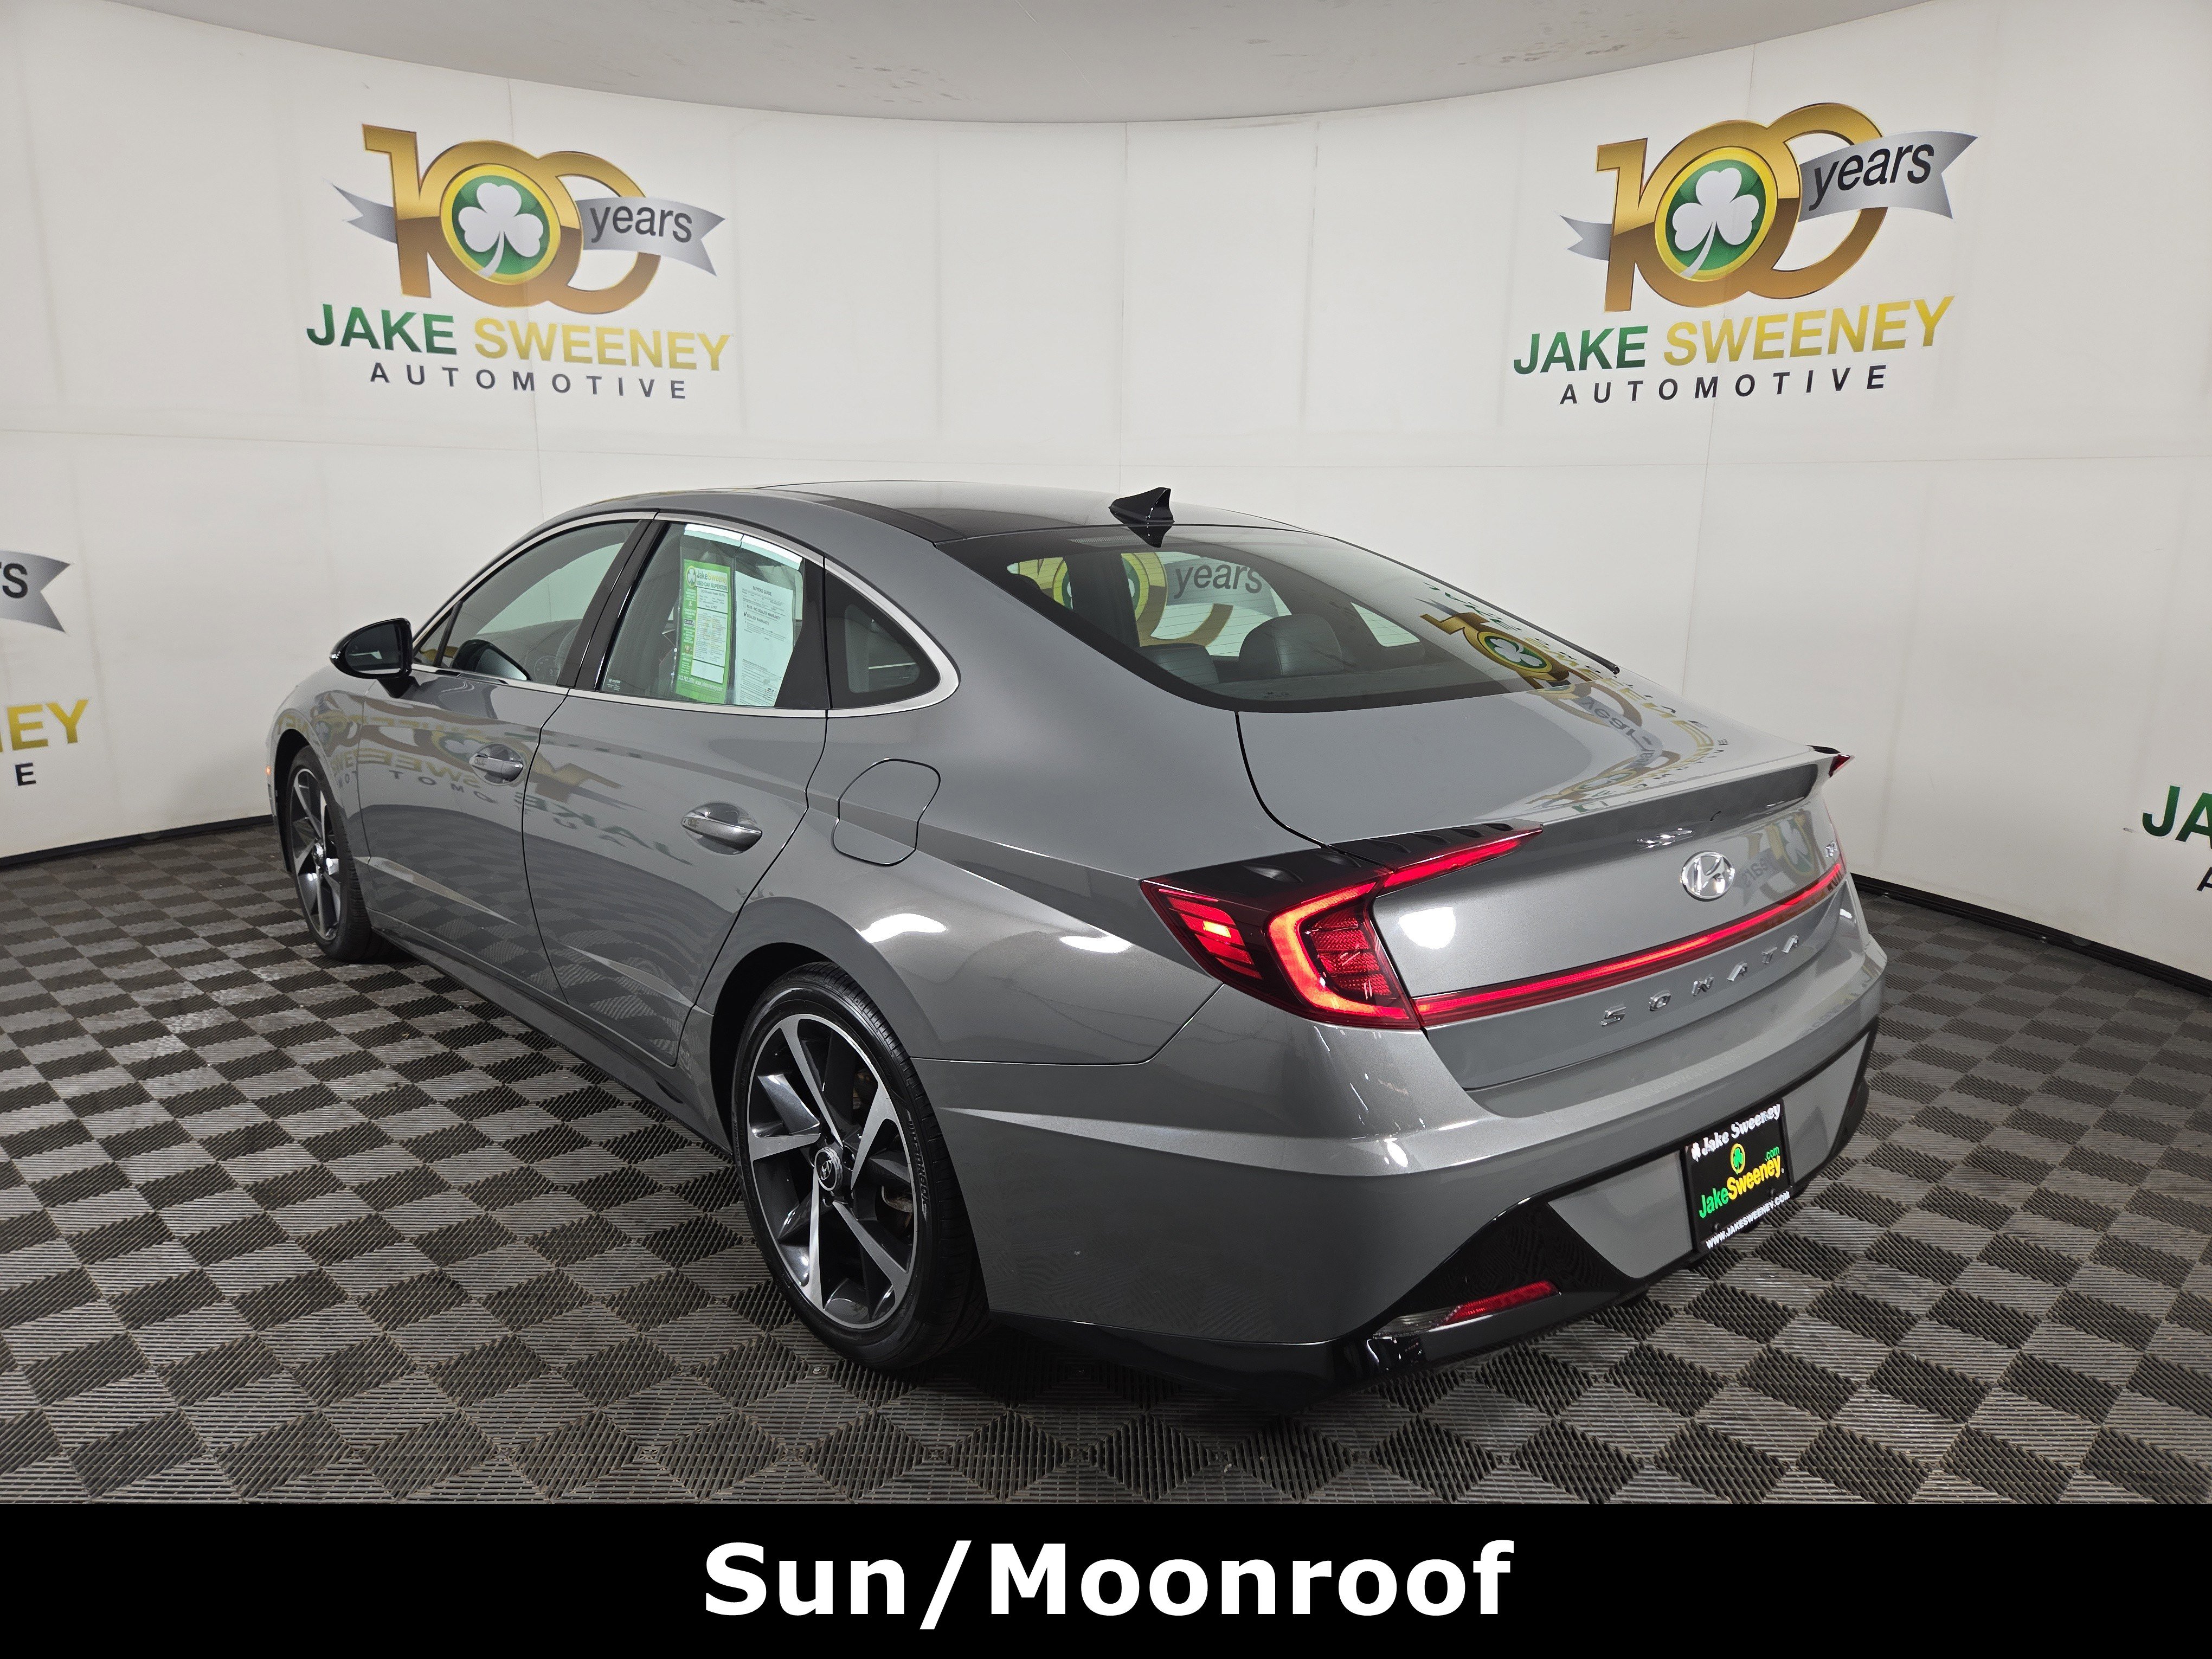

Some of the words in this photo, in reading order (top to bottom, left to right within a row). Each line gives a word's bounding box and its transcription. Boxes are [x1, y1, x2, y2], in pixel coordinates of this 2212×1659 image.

[1809, 143, 1934, 211] years
[589, 202, 693, 243] years
[306, 304, 457, 355] JAKE
[474, 318, 731, 371] SWEENEY
[1514, 325, 1648, 375] JAKE
[1664, 295, 1955, 366] SWEENEY
[370, 362, 686, 399] AUTOMOTIVE
[1559, 365, 1887, 405] AUTOMOTIVE
[1174, 563, 1263, 599] years
[1600, 934, 1799, 1026] SONATA
[1702, 1132, 1729, 1156] Jake
[1731, 1104, 1780, 1139] Sweeney
[1699, 1155, 1781, 1218] JakeSweeney
